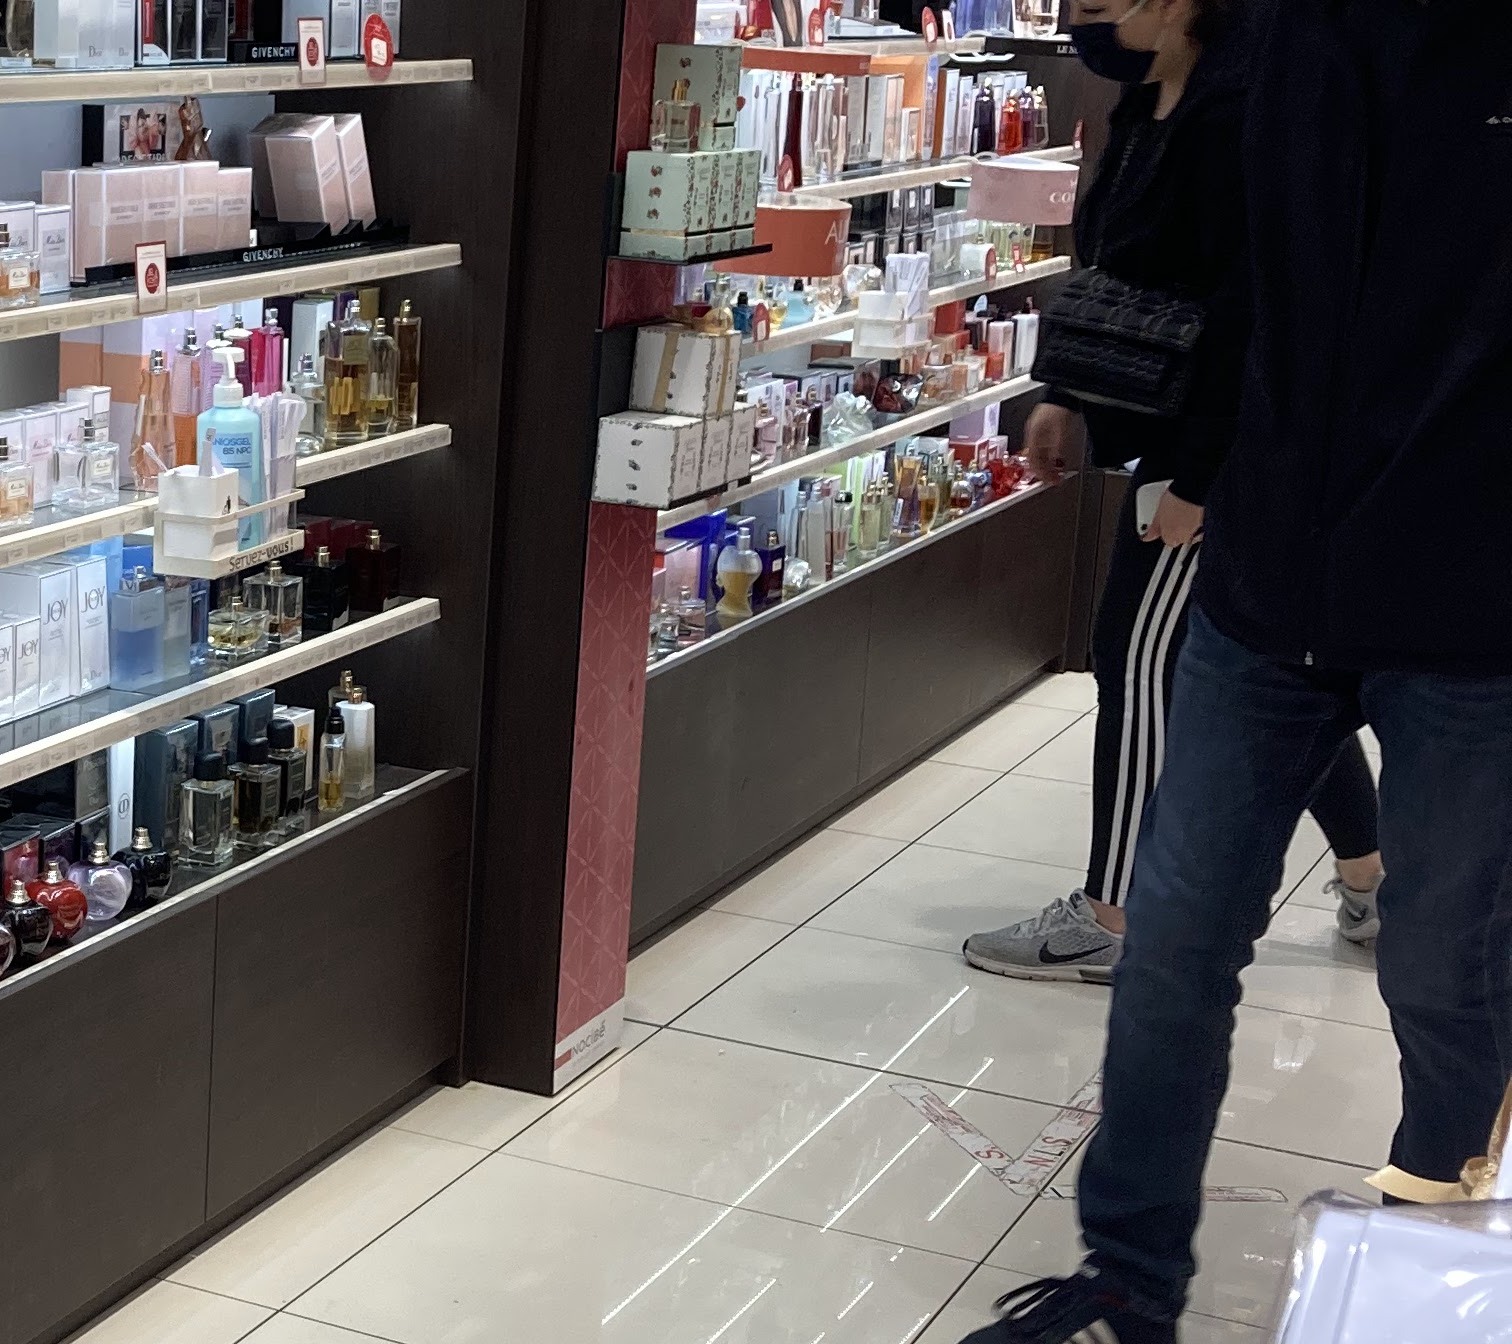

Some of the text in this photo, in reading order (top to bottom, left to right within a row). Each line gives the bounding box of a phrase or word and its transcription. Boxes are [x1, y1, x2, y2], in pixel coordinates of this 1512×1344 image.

[251, 45, 297, 60] GIVENCHY
[242, 246, 285, 264] GIVENCHY
[222, 446, 252, 455] 85 NPC
[82, 585, 106, 614] JOY
[42, 600, 69, 626] JOY
[19, 638, 39, 660] JOY
